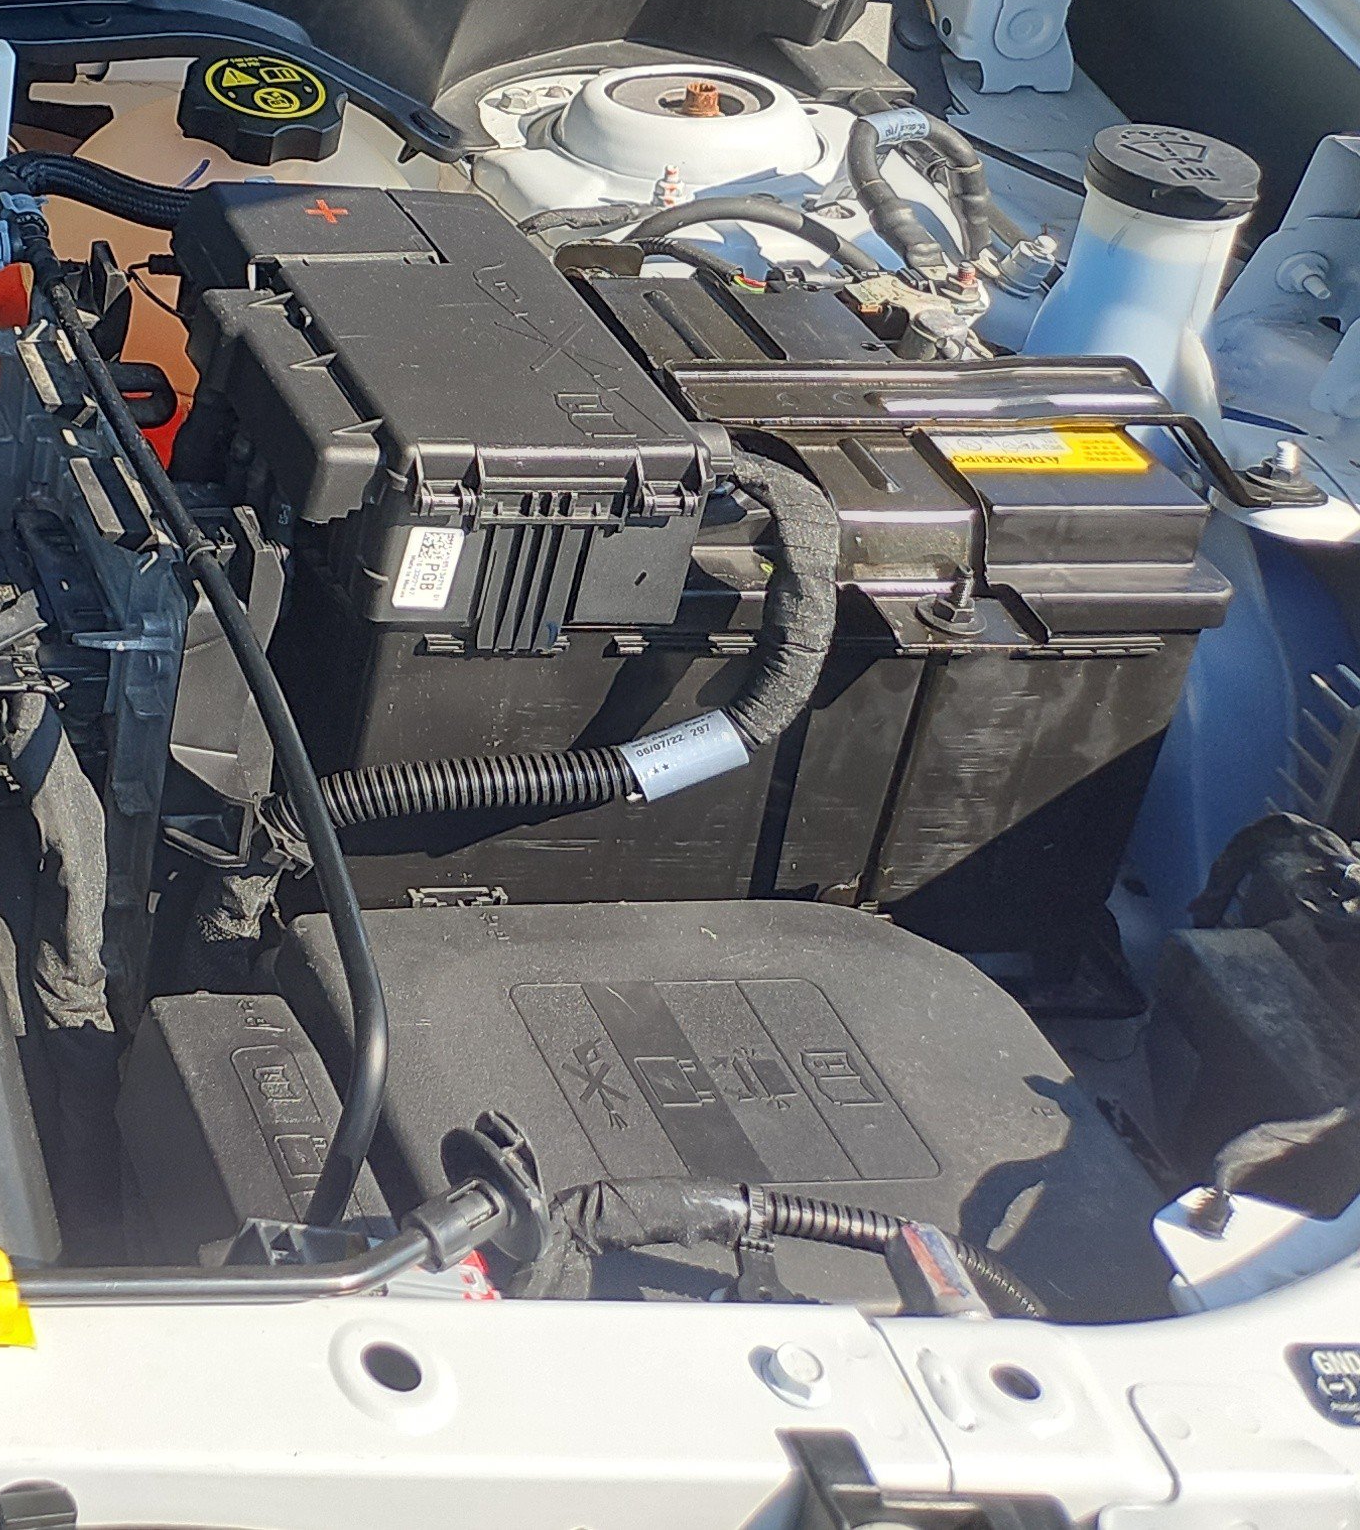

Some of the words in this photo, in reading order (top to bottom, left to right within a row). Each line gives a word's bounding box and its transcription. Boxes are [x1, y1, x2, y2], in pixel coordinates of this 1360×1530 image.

[420, 563, 440, 590] PGB
[690, 724, 711, 737] 297
[1311, 1350, 1360, 1375] GND
